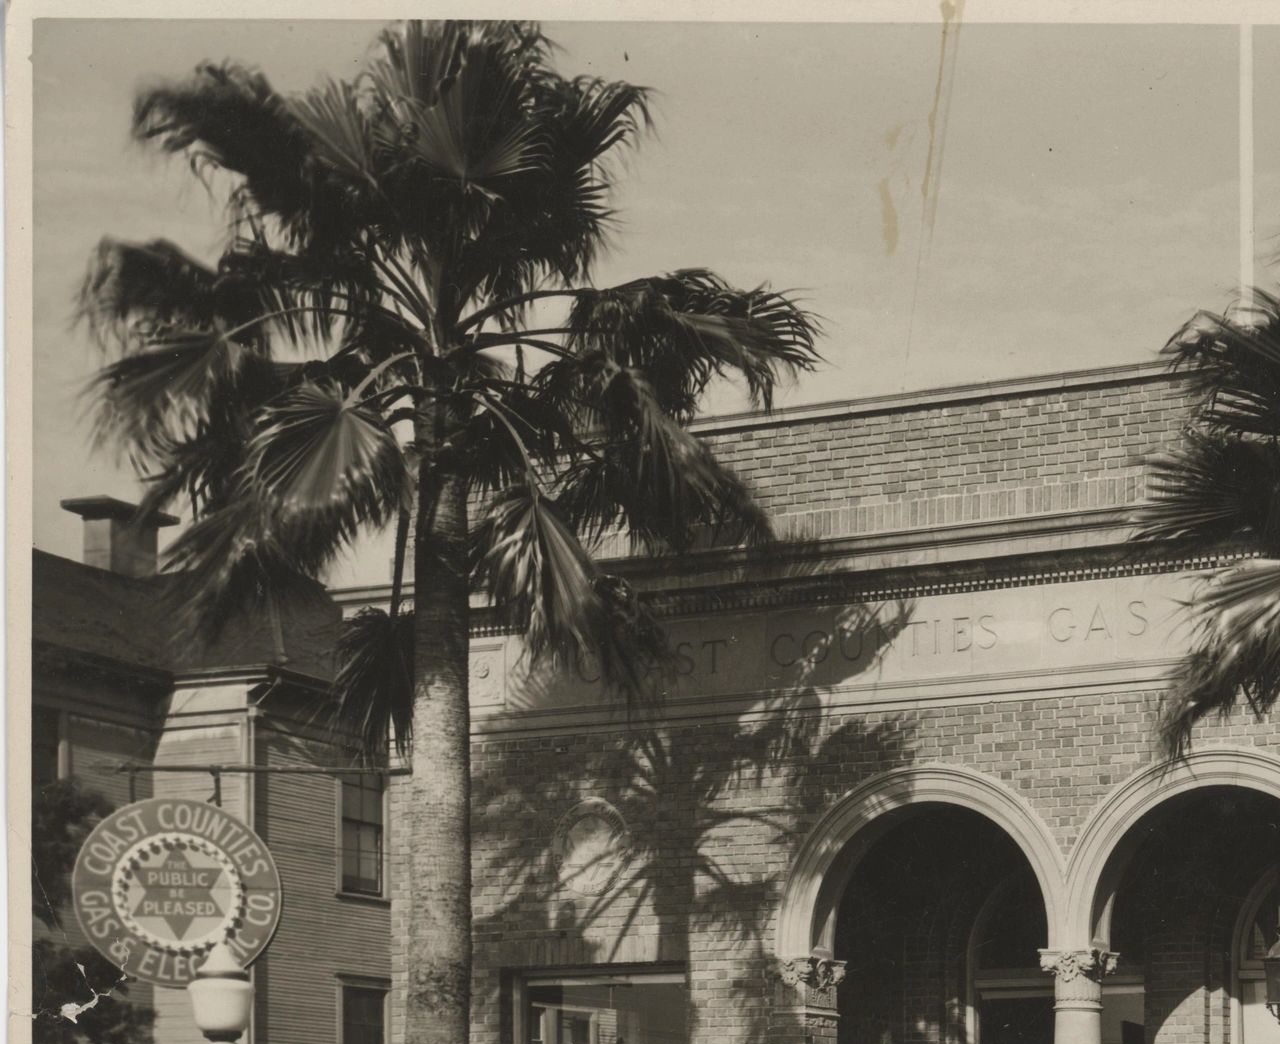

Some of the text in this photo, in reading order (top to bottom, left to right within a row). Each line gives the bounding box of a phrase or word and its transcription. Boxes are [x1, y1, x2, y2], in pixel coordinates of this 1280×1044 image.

[577, 638, 728, 683] CST
[771, 614, 998, 668] COUNTIES
[1047, 600, 1149, 644] GAS
[84, 803, 269, 877] COAST COUNTIES
[167, 861, 188, 870] THE
[148, 872, 209, 886] PUBLIC
[169, 889, 185, 899] BE
[144, 901, 216, 916] PLEASED
[80, 891, 120, 938] GAS
[137, 937, 260, 981] ELECIC
[244, 892, 275, 927] CO.
